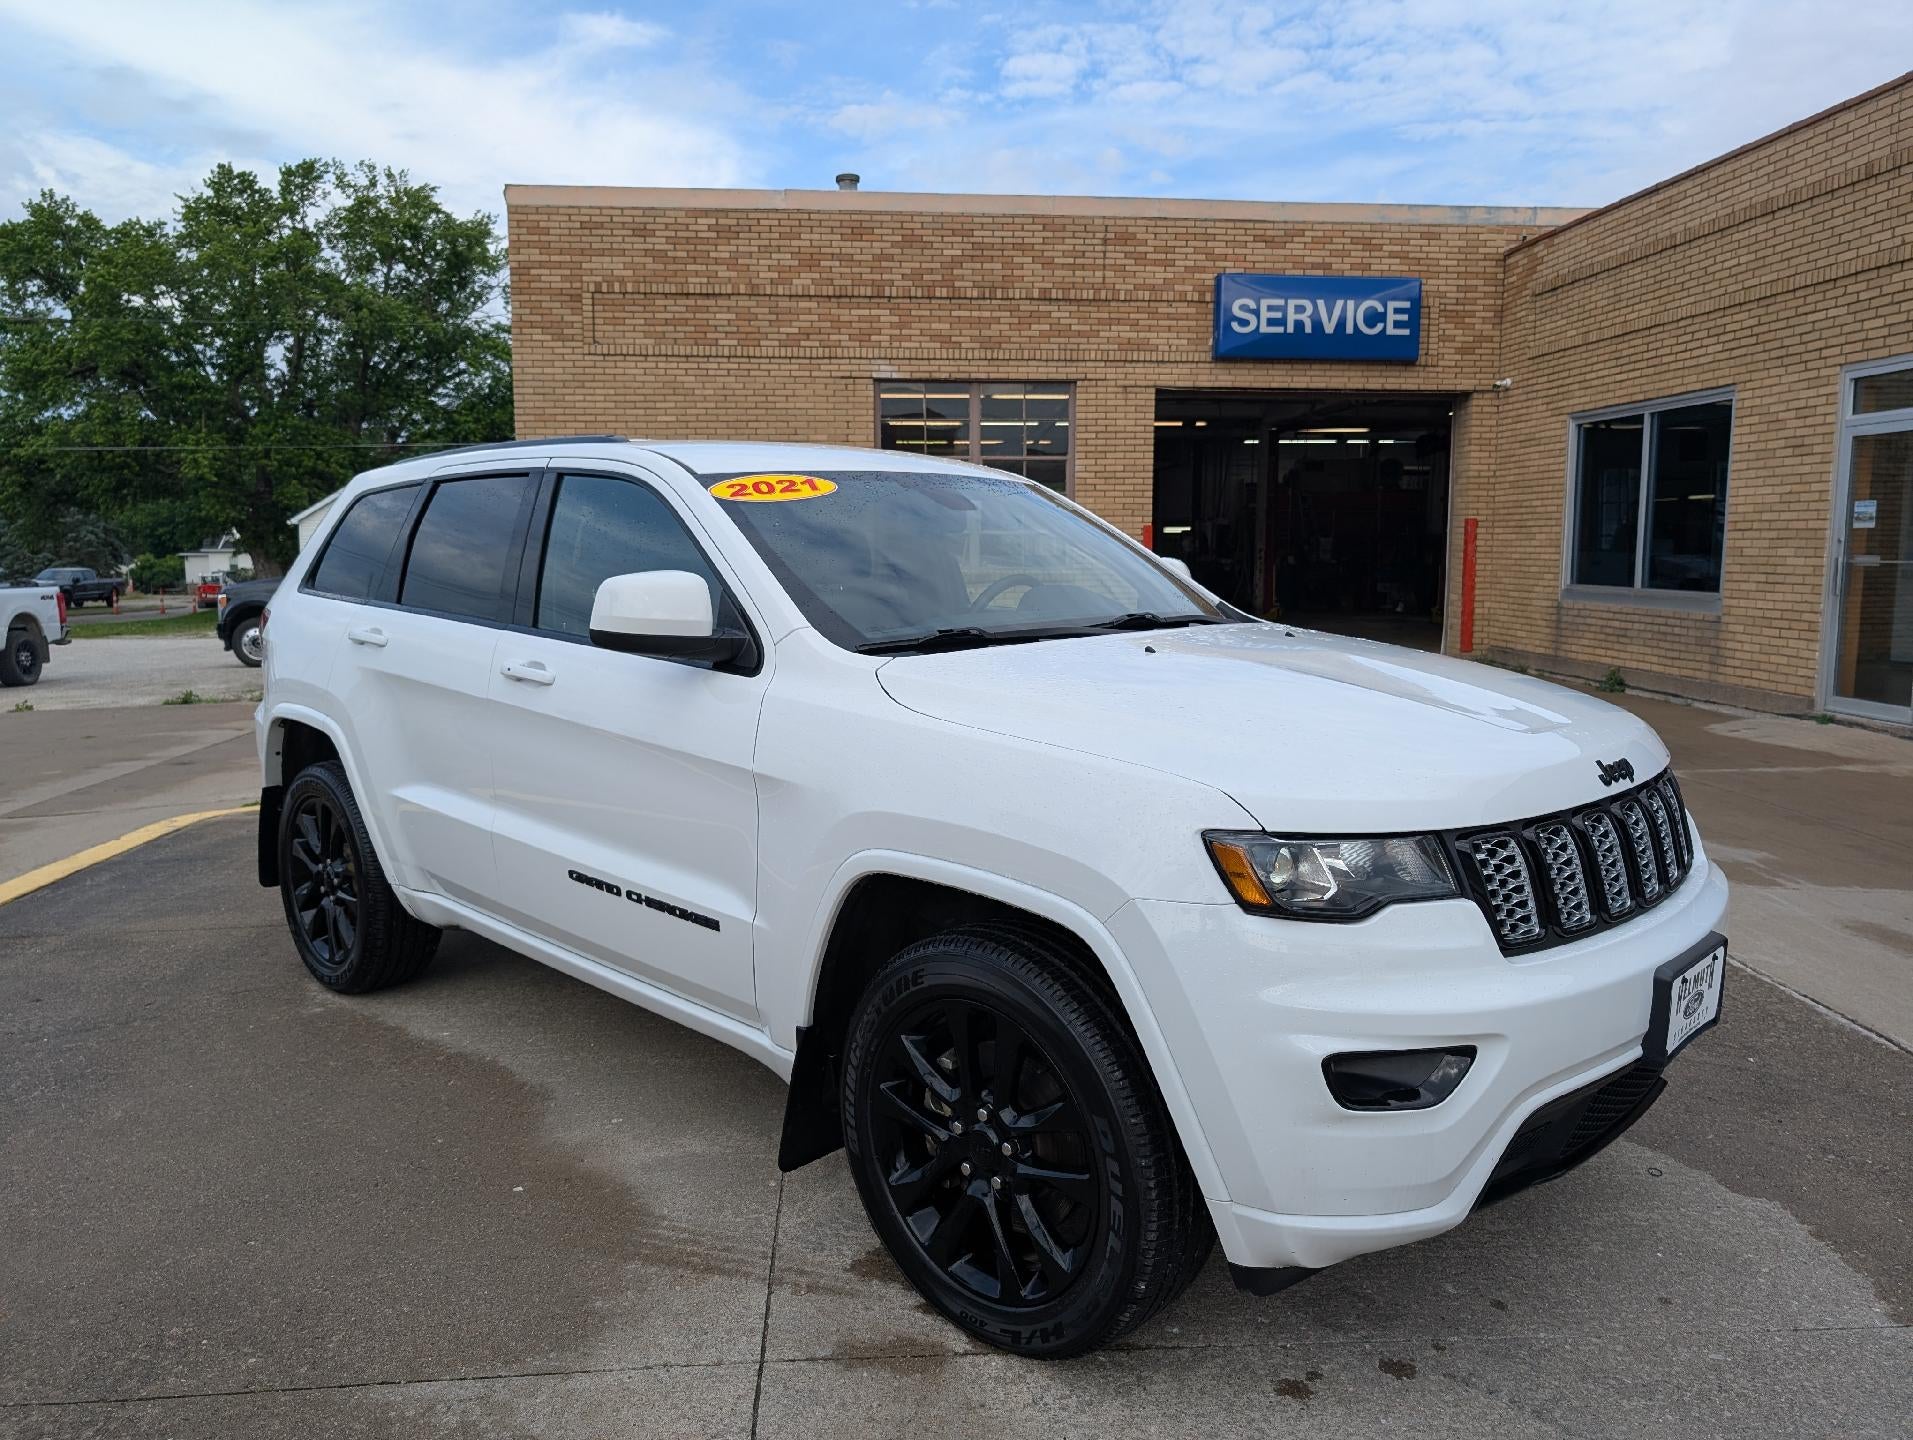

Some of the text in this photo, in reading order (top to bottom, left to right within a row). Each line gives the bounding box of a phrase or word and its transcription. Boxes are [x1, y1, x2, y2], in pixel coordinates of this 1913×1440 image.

[1230, 298, 1411, 336] SERVICE
[726, 478, 820, 497] 2021
[1595, 757, 1635, 787] Jeep
